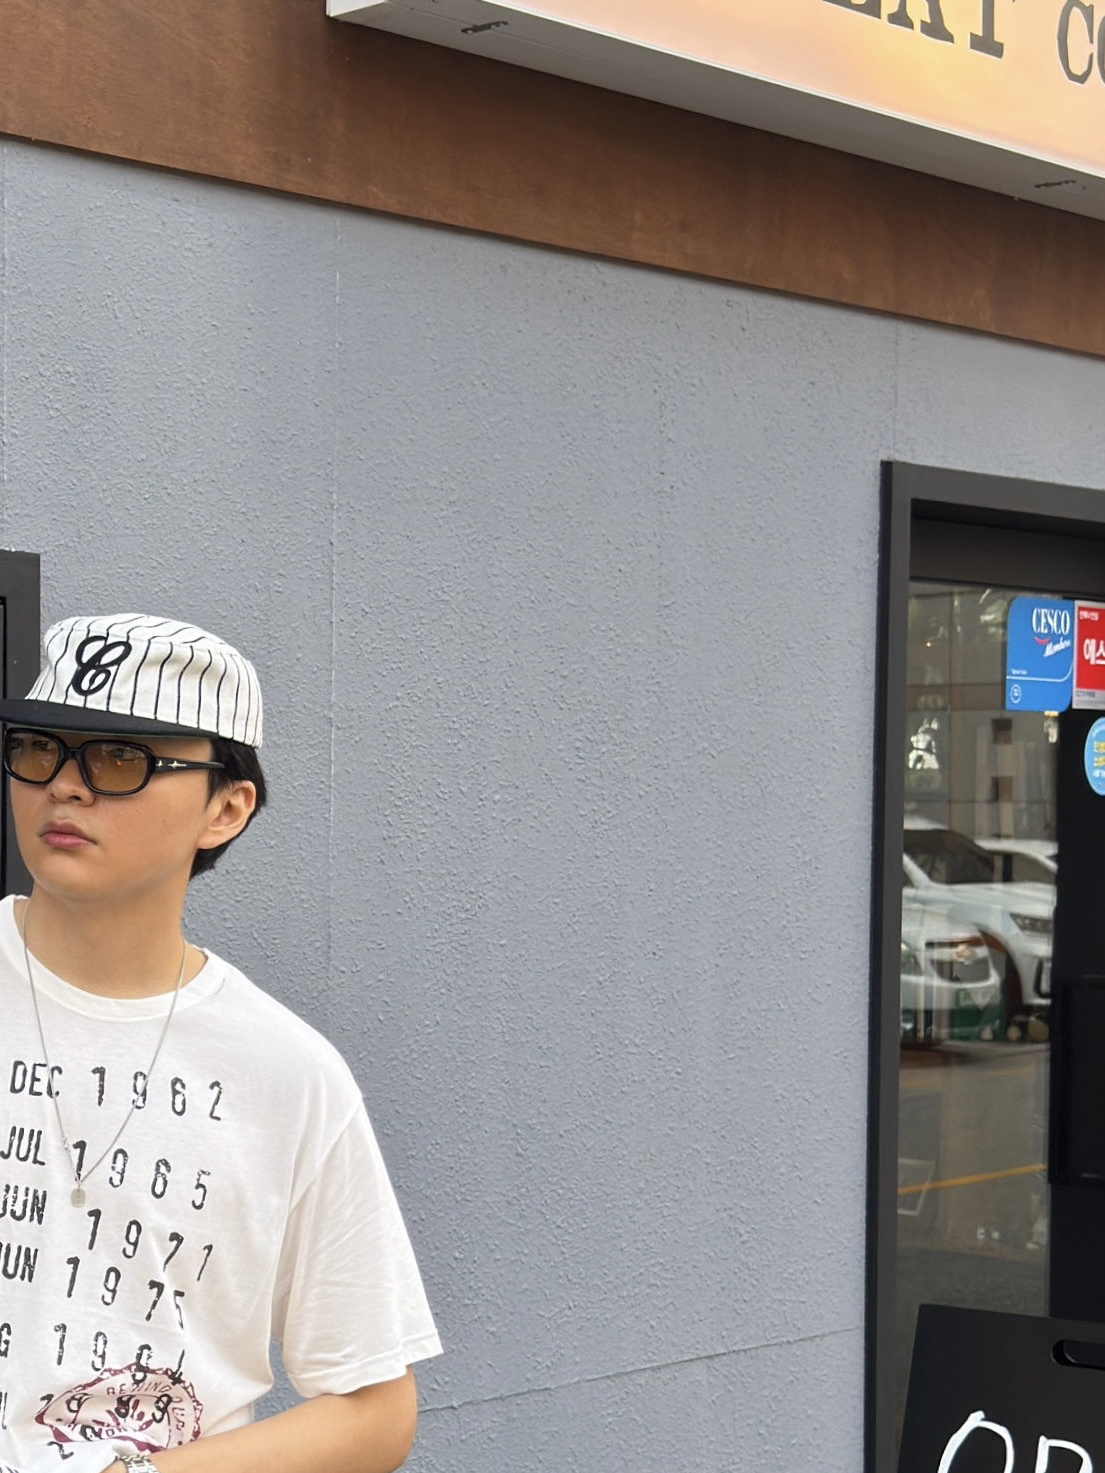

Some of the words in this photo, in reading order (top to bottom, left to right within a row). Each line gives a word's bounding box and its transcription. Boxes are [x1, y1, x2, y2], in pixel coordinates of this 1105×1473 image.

[1057, 0, 1105, 85] C
[1032, 608, 1070, 635] CESCO
[9, 1060, 62, 1098] DEC
[0, 1126, 46, 1166] JUL
